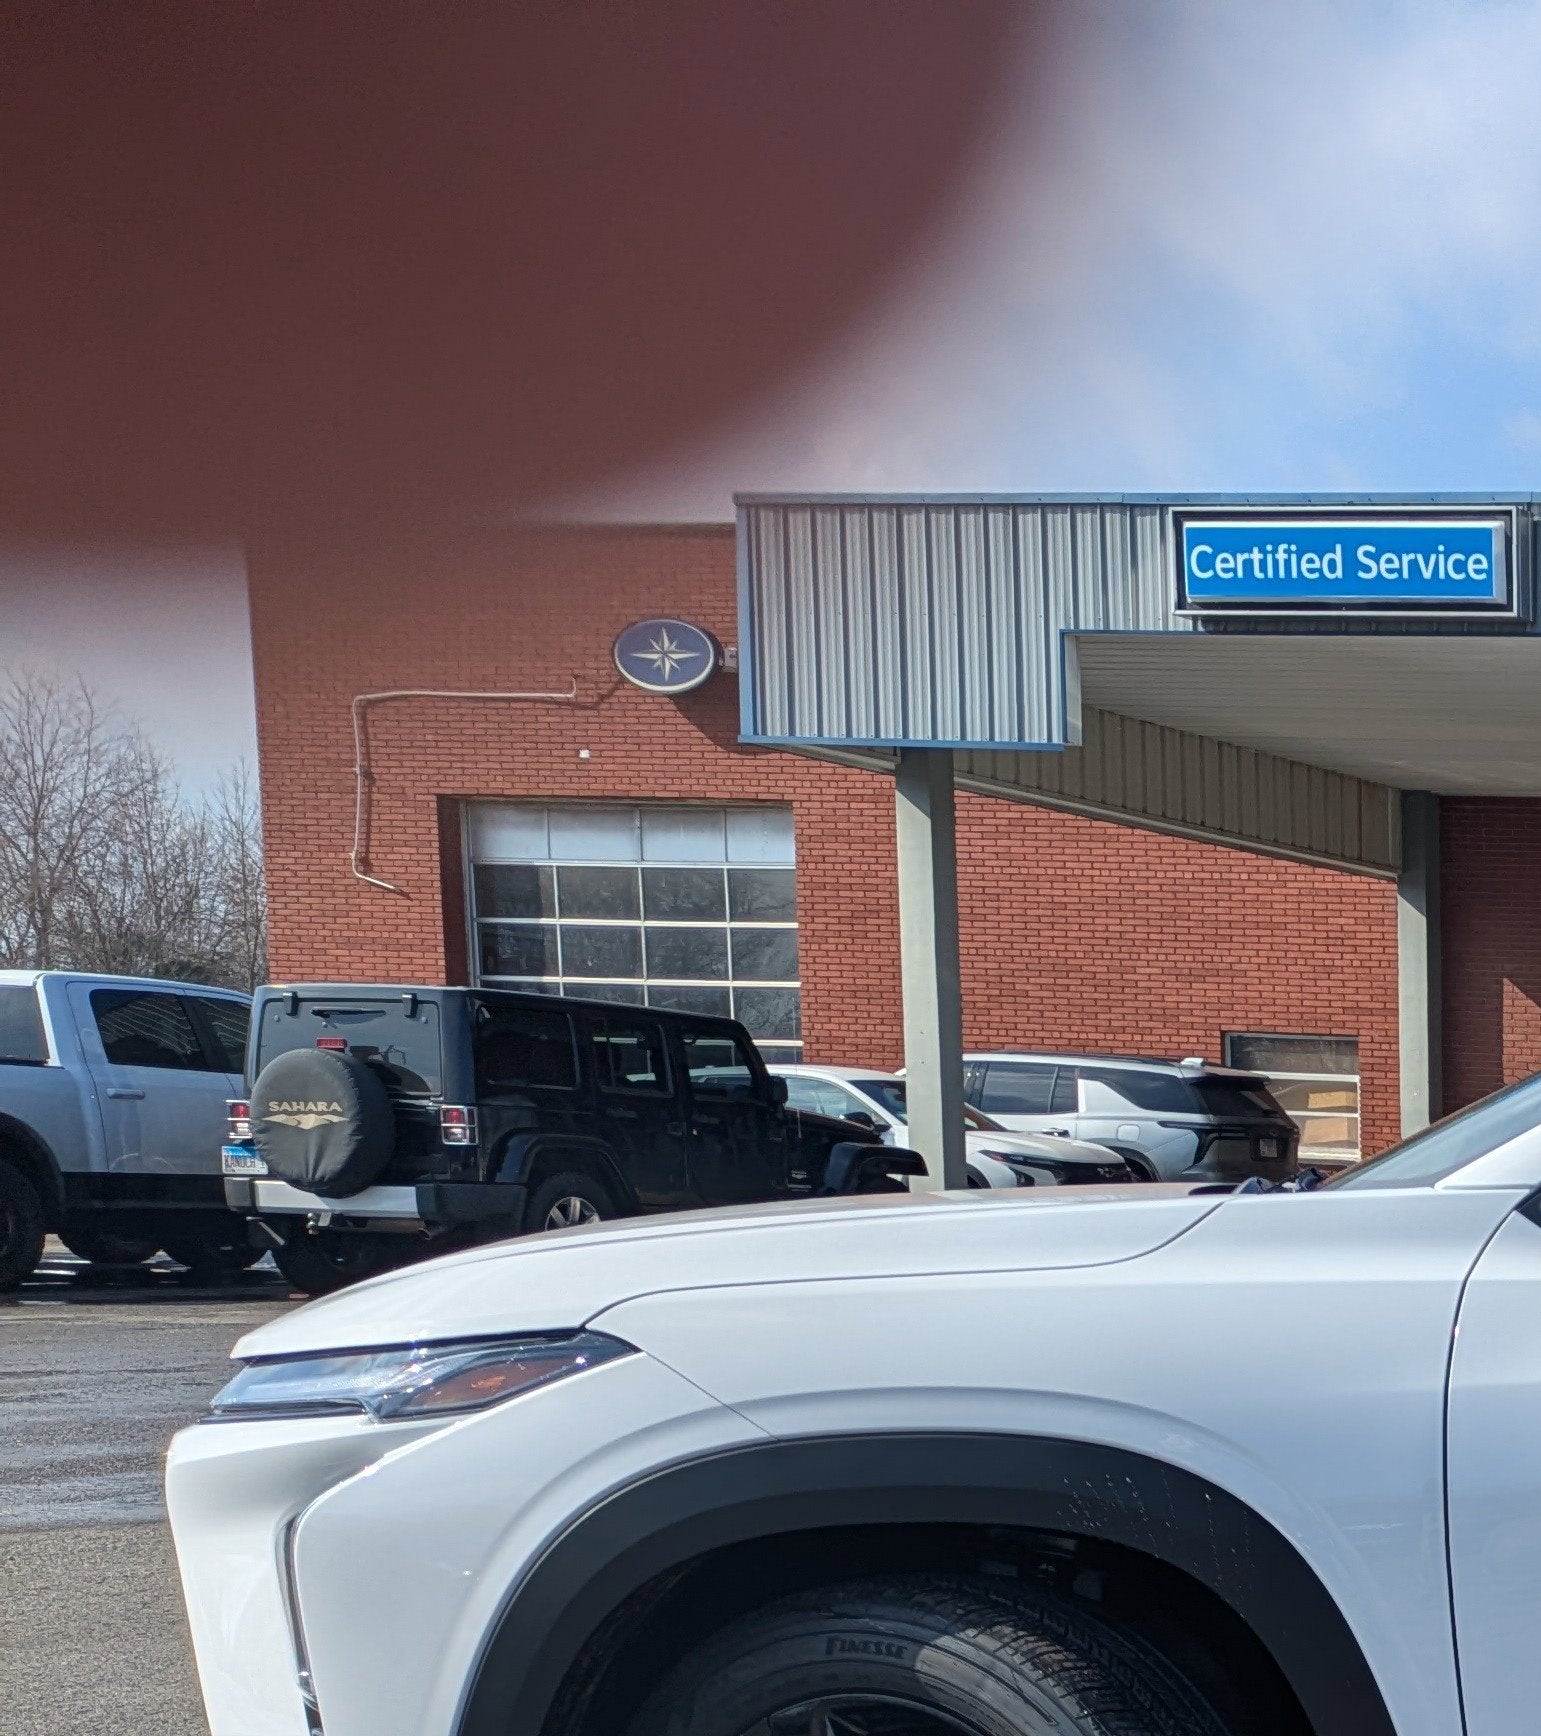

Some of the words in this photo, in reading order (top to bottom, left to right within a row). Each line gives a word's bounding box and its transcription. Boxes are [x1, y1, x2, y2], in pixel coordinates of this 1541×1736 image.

[1190, 544, 1343, 579] Certified
[1357, 545, 1489, 580] Service
[268, 1100, 343, 1113] SAHARA
